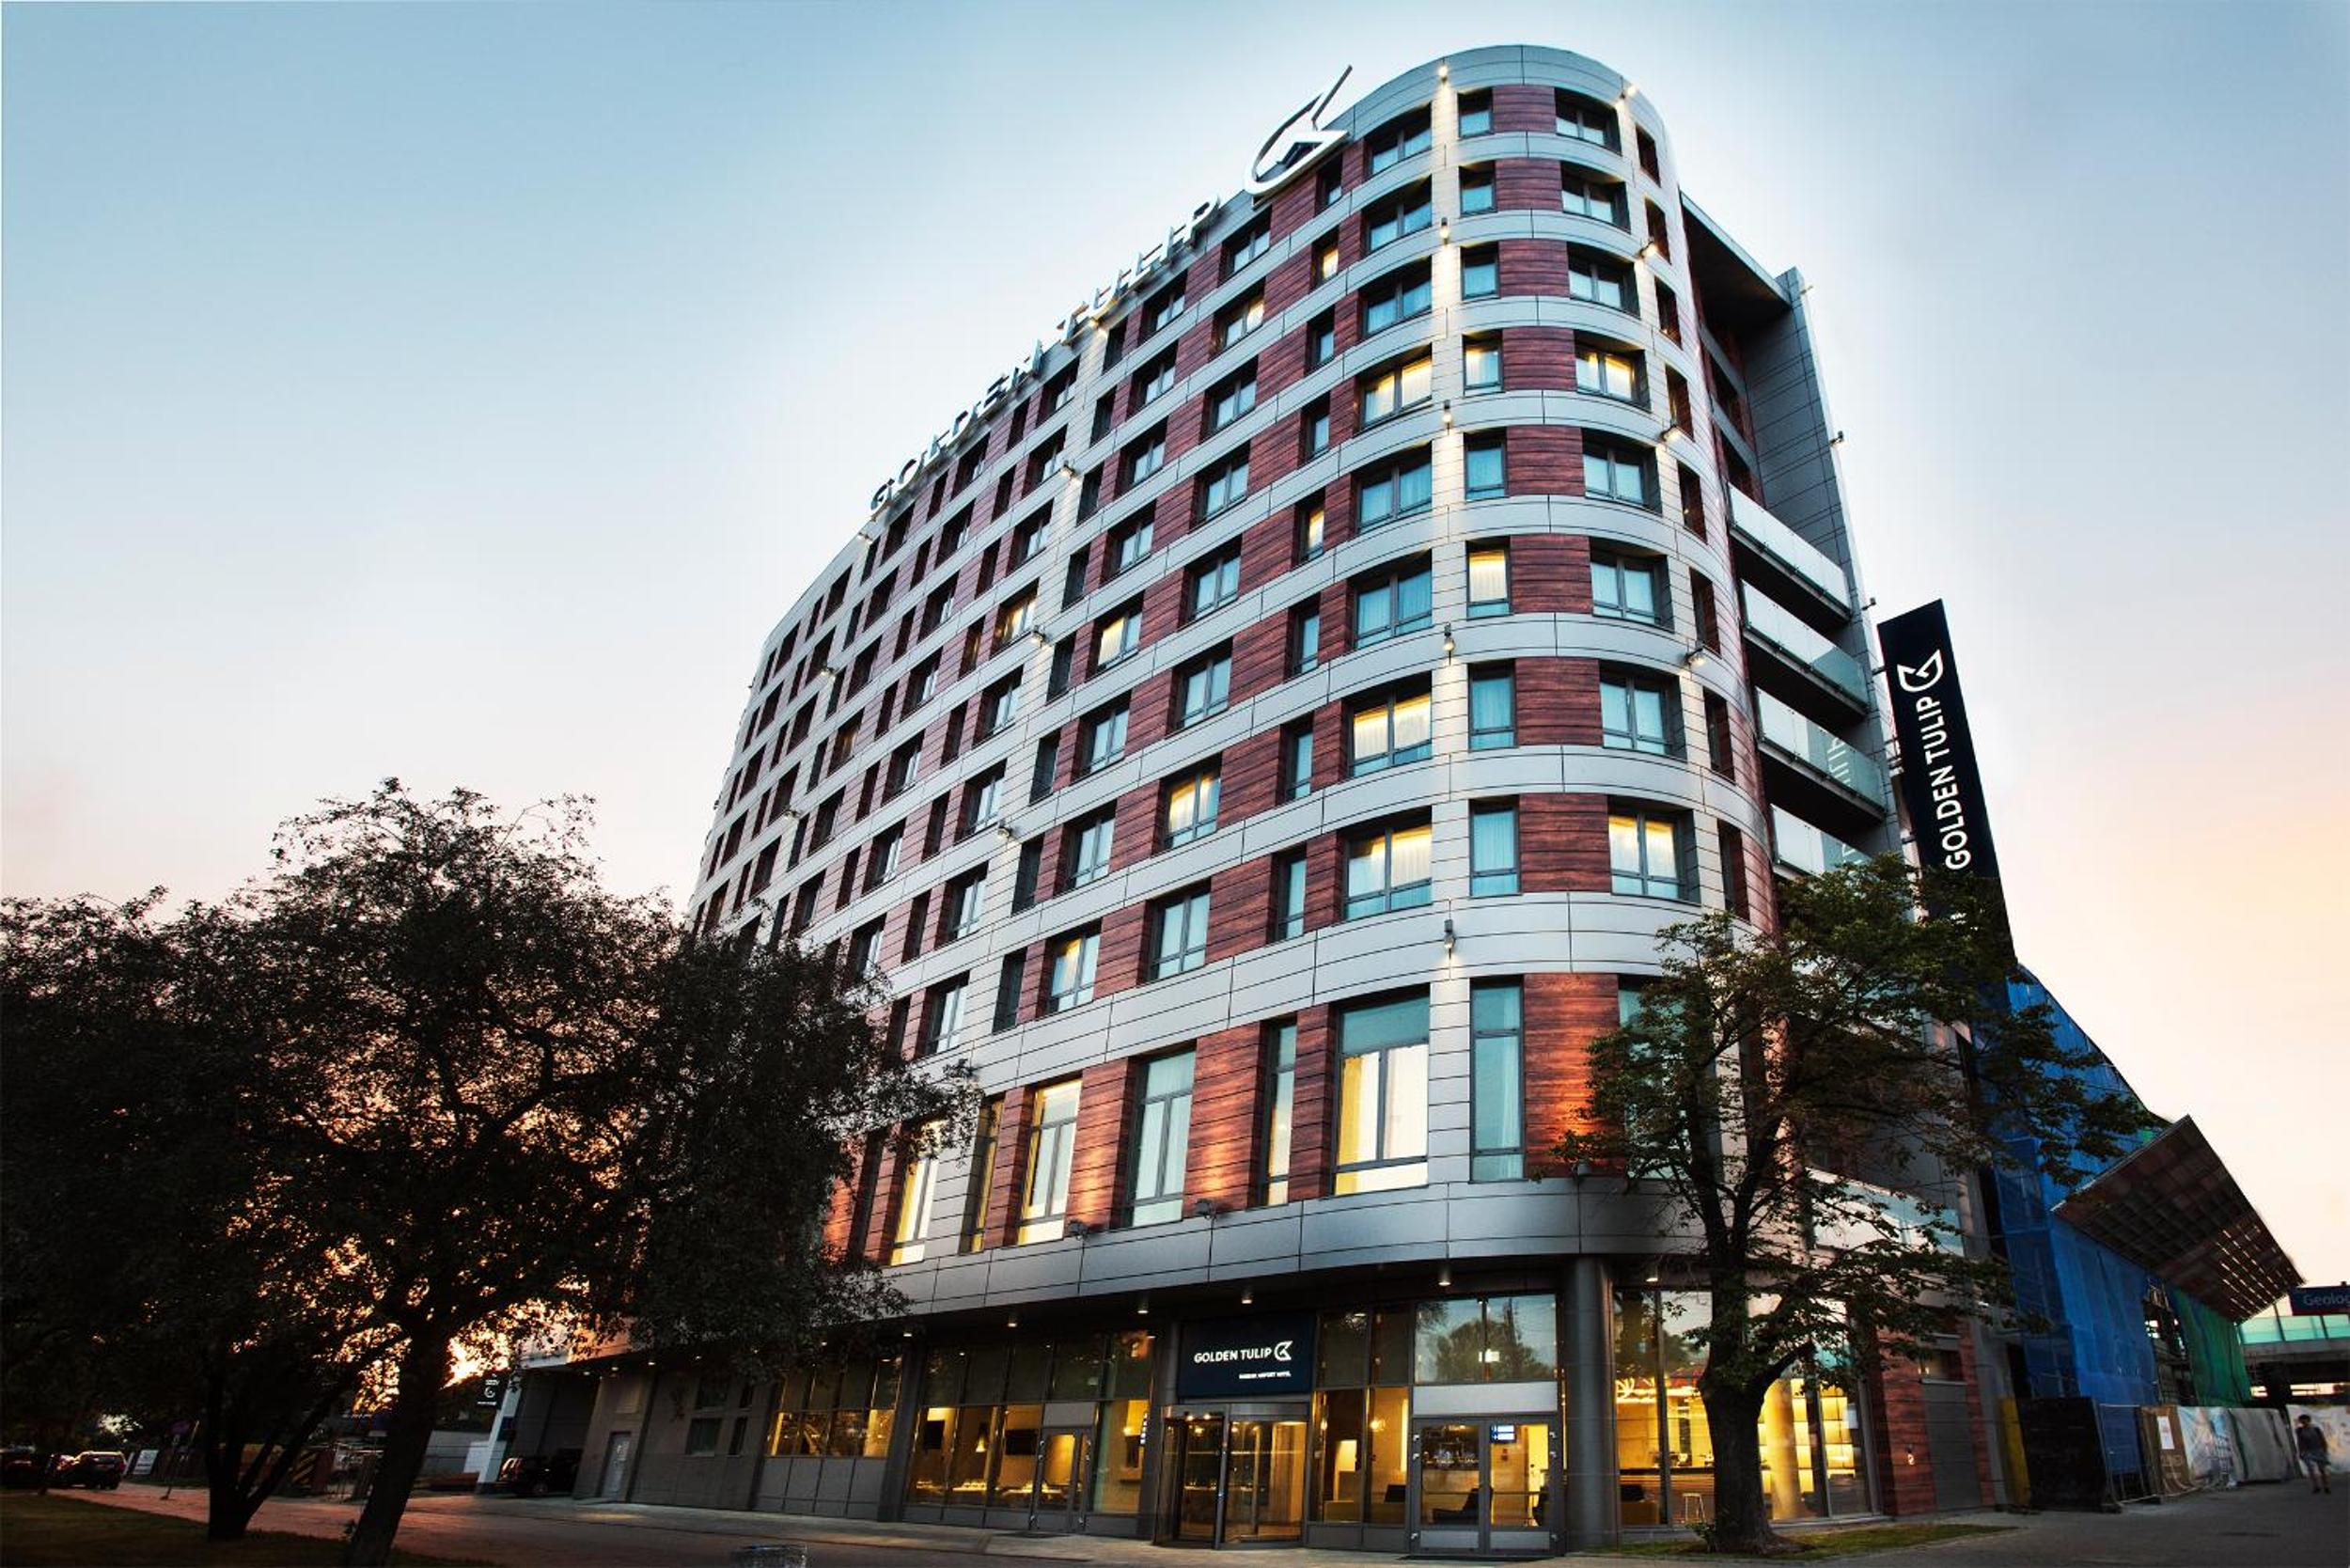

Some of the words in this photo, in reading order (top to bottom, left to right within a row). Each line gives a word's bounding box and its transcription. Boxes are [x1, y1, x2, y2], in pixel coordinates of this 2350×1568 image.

[1916, 696, 1950, 764] TULIP
[1930, 765, 1972, 870] GOLDEN
[1194, 1350, 1238, 1363] GOLDEN
[1240, 1347, 1273, 1360] TULIP
